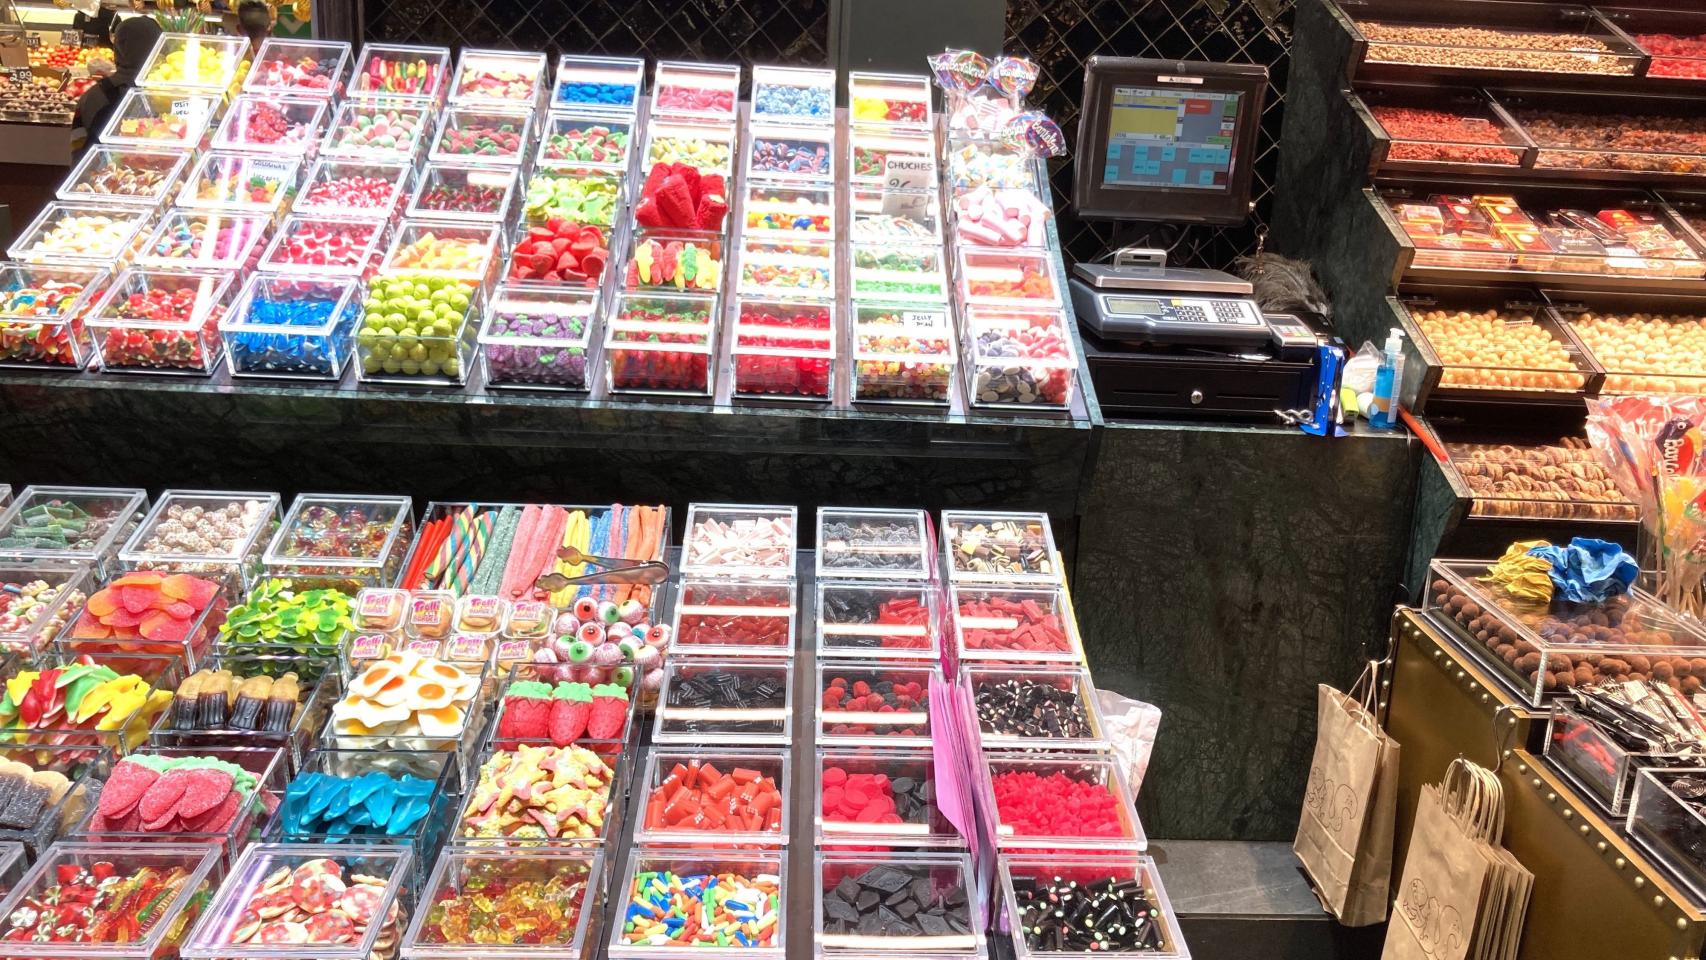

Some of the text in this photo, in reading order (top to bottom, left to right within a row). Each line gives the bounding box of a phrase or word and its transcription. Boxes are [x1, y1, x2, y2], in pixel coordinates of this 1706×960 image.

[887, 161, 933, 171] CHUCHES
[365, 594, 392, 605] Trolli
[471, 598, 497, 607] Trolli
[414, 600, 441, 612] Trolli
[515, 603, 542, 611] Trolli
[356, 636, 382, 647] Trolli
[411, 641, 437, 649] Trolli
[457, 636, 482, 645] Trolli
[501, 640, 529, 651] Trolli
